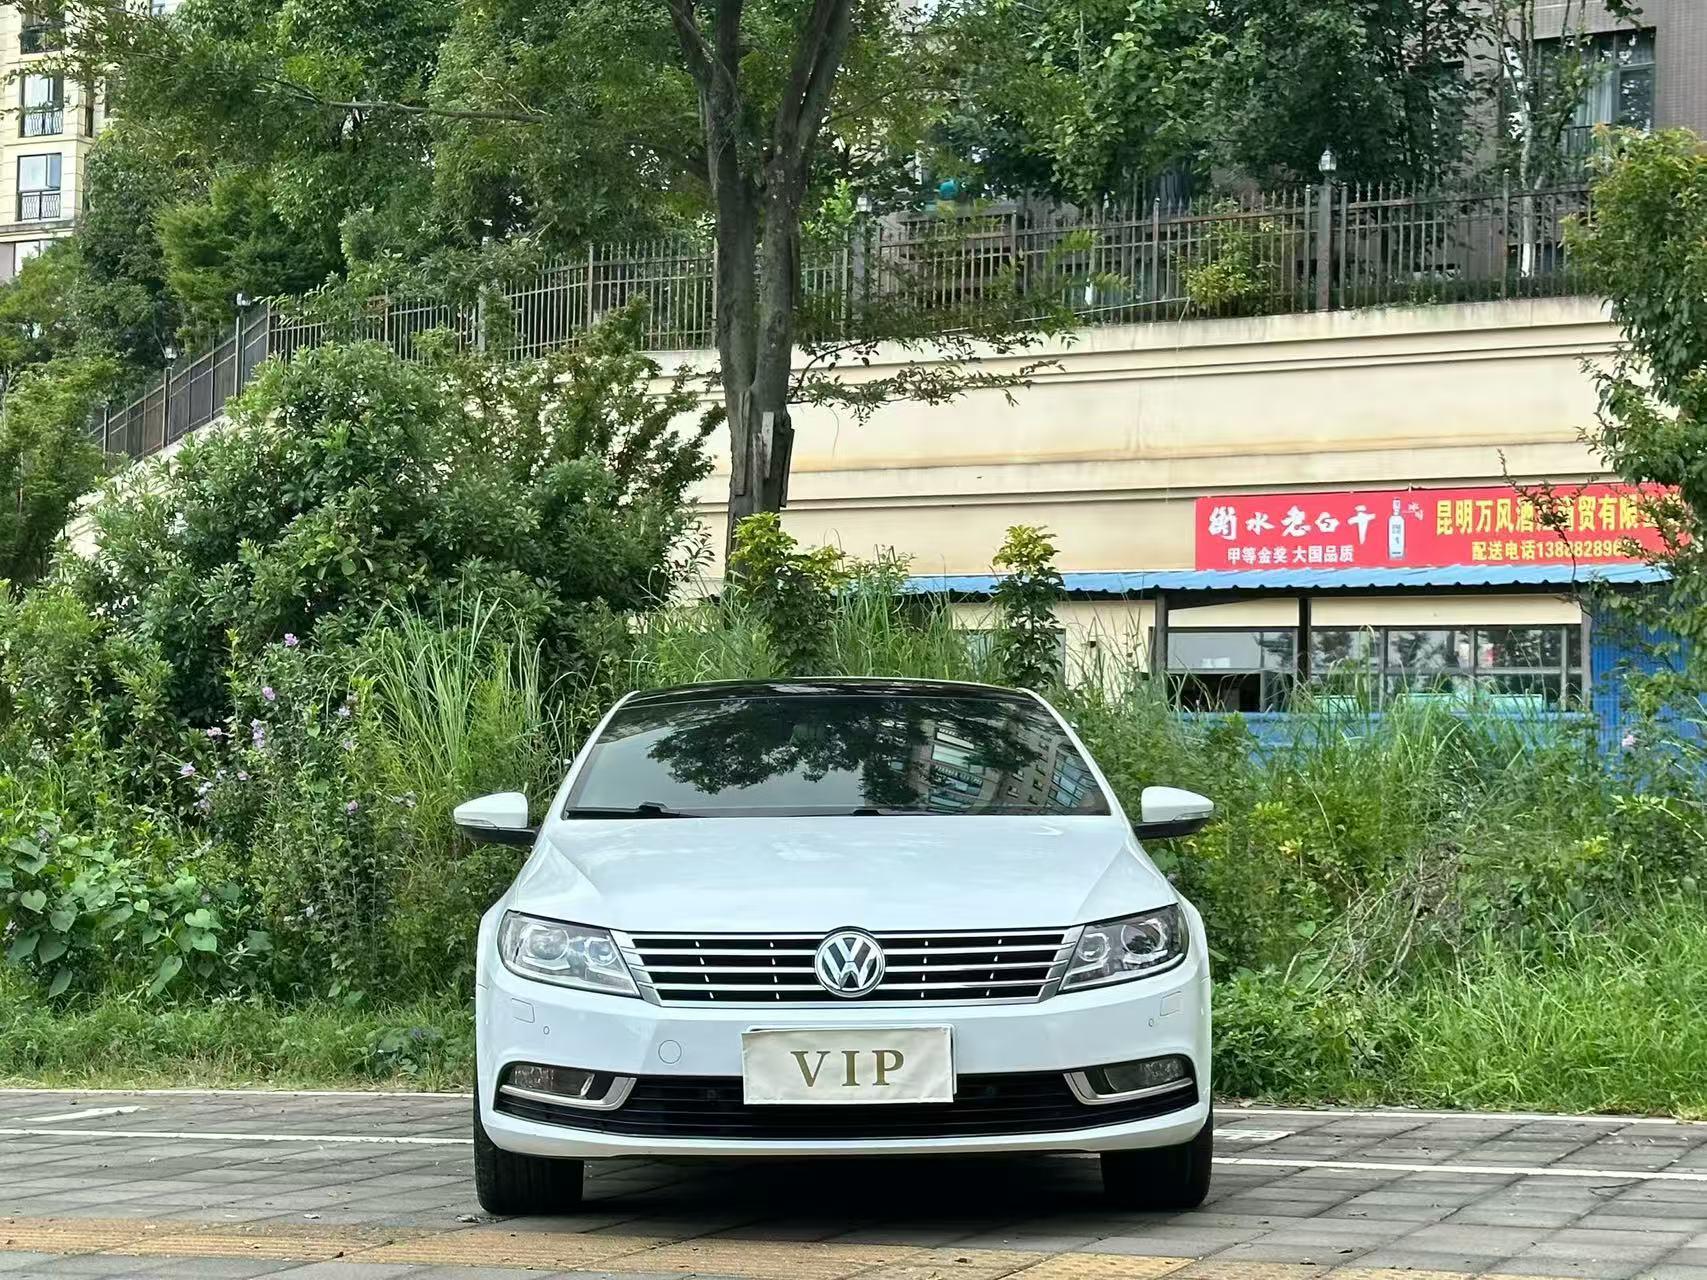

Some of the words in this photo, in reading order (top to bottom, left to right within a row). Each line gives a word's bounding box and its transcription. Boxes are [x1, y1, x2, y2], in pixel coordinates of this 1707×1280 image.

[1208, 505, 1376, 544] 衡水老白干
[1227, 546, 1288, 564] 甲等金奖
[1292, 544, 1354, 564] 大国品质
[790, 1050, 904, 1087] VIP
